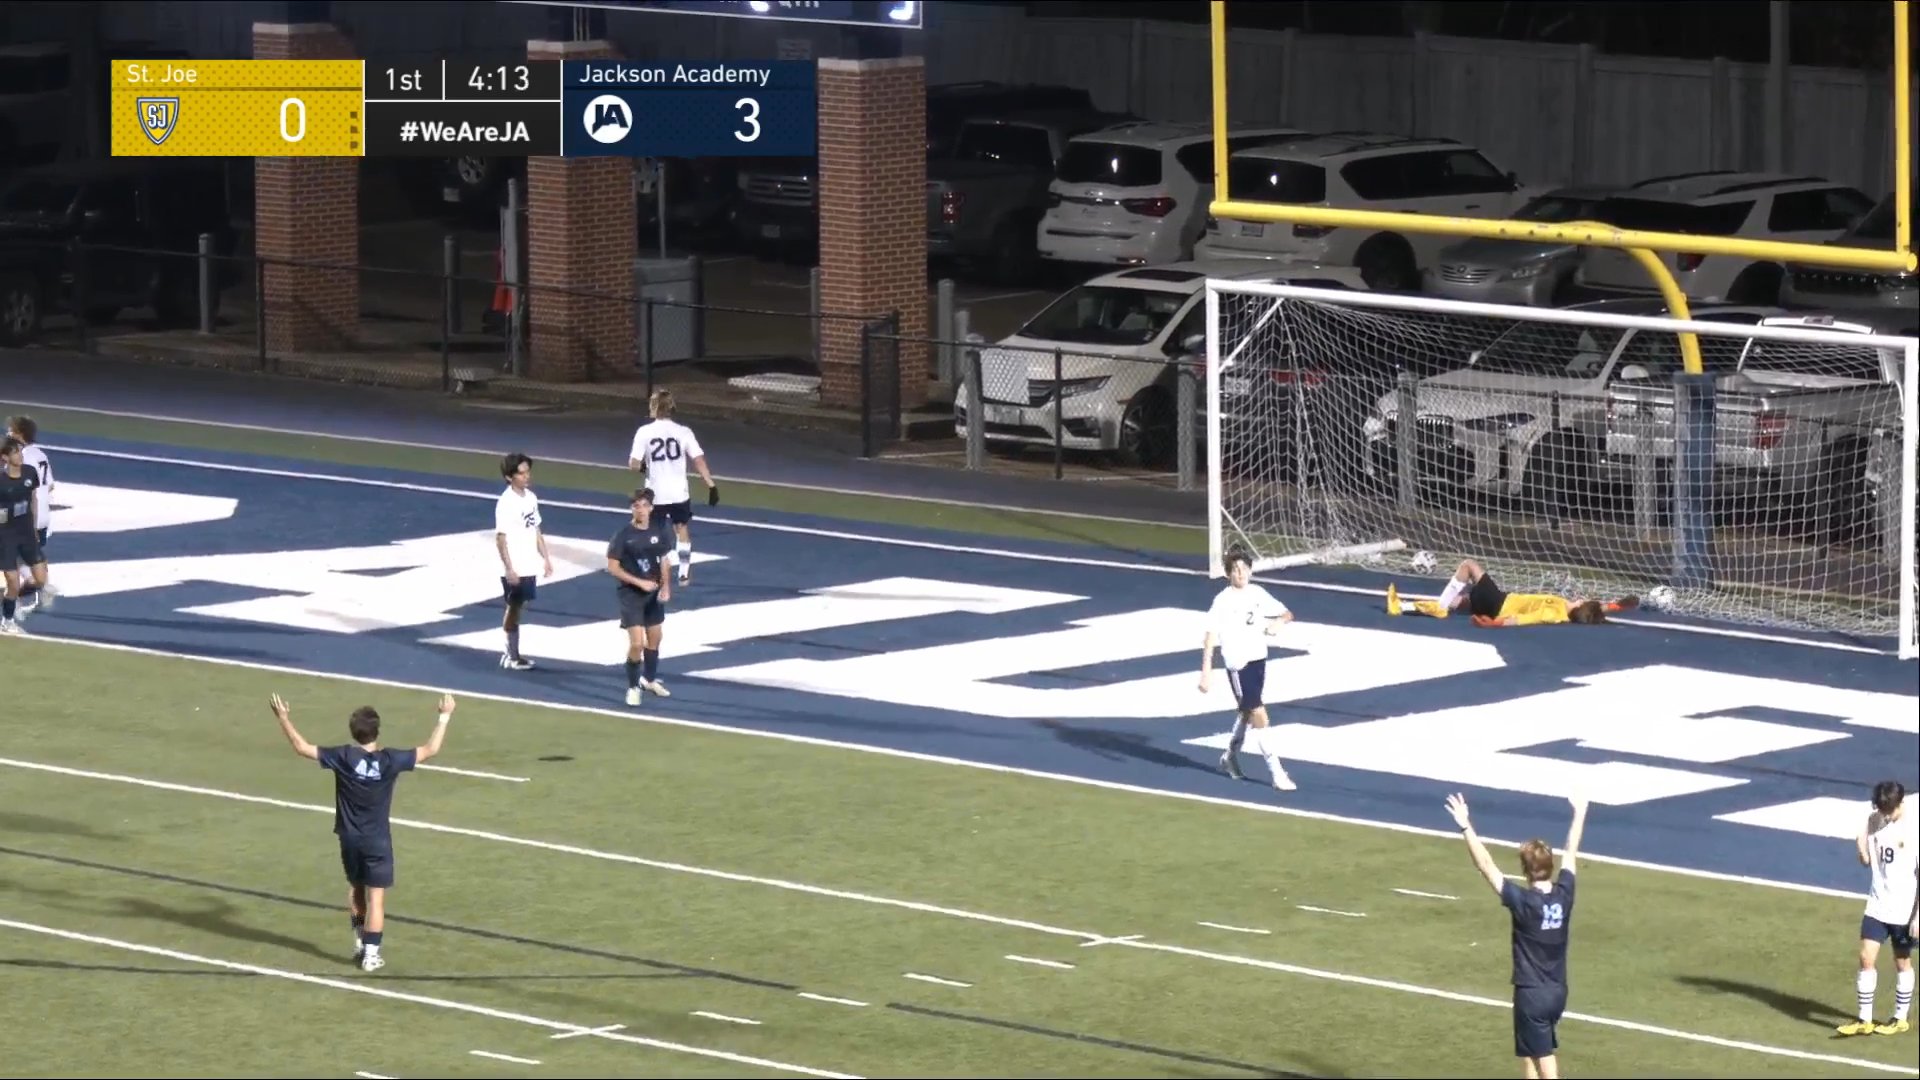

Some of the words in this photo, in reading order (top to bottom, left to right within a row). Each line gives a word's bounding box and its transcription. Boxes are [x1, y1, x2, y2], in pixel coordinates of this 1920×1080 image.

[649, 436, 681, 462] 20
[1246, 612, 1255, 626] 2
[1879, 845, 1895, 864] 19
